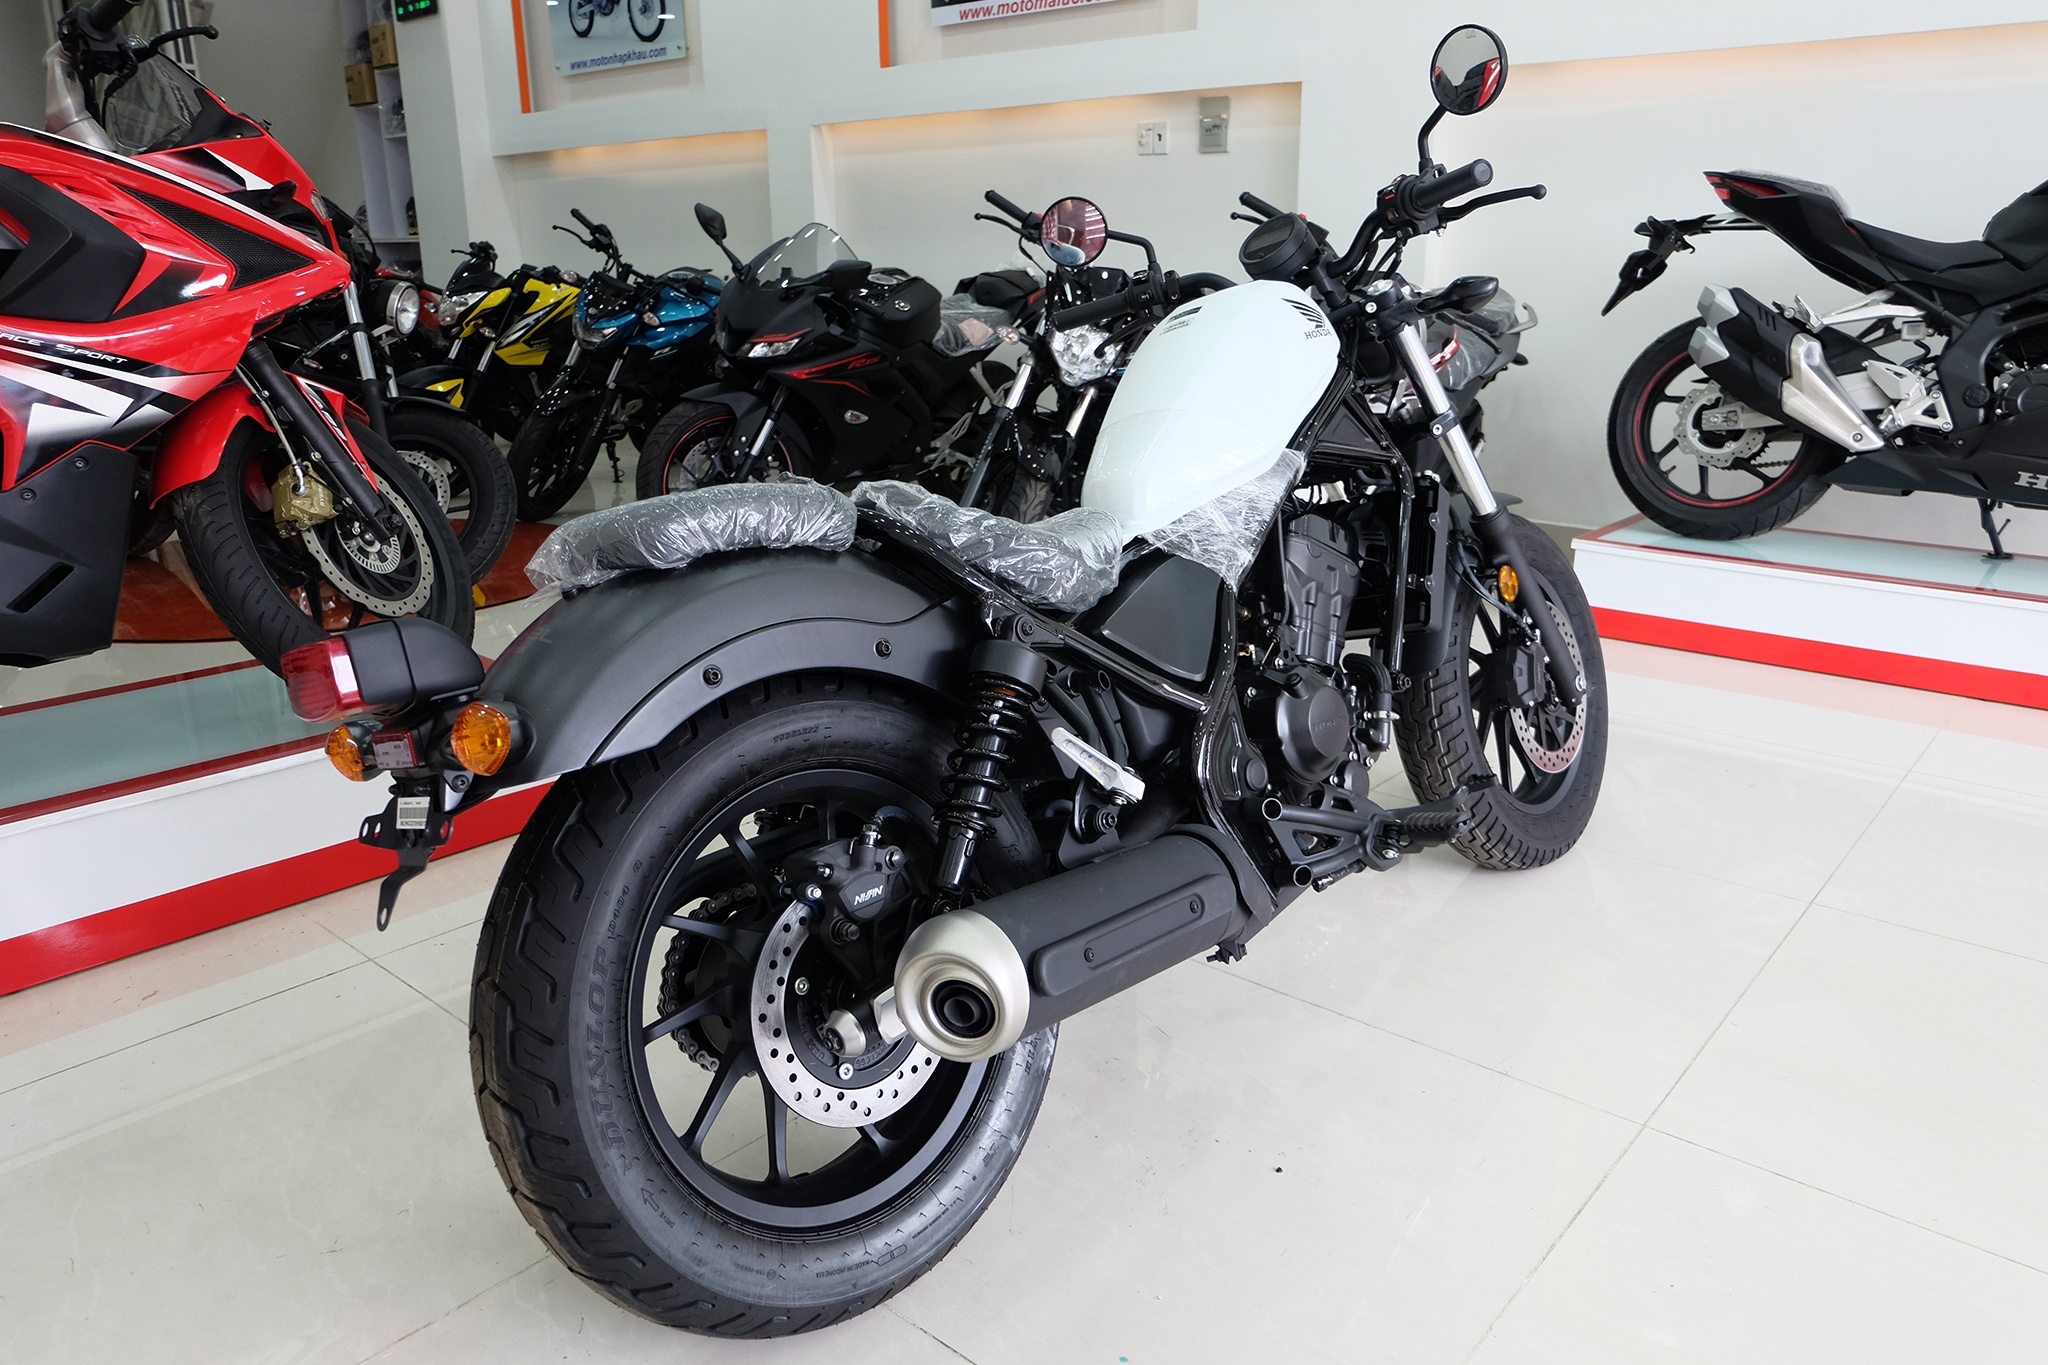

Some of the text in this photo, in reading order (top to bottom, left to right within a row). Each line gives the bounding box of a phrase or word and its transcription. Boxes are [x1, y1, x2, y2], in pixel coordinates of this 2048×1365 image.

[570, 46, 667, 70] www.motonhapkhau.com
[1304, 328, 1333, 341] HONDA
[0, 331, 127, 363] ACE SPORT
[587, 945, 627, 1150] DUNLOP
[658, 1211, 676, 1229] DRIVE
[815, 1268, 847, 1280] INDONESIA
[854, 1259, 871, 1271] MADE
